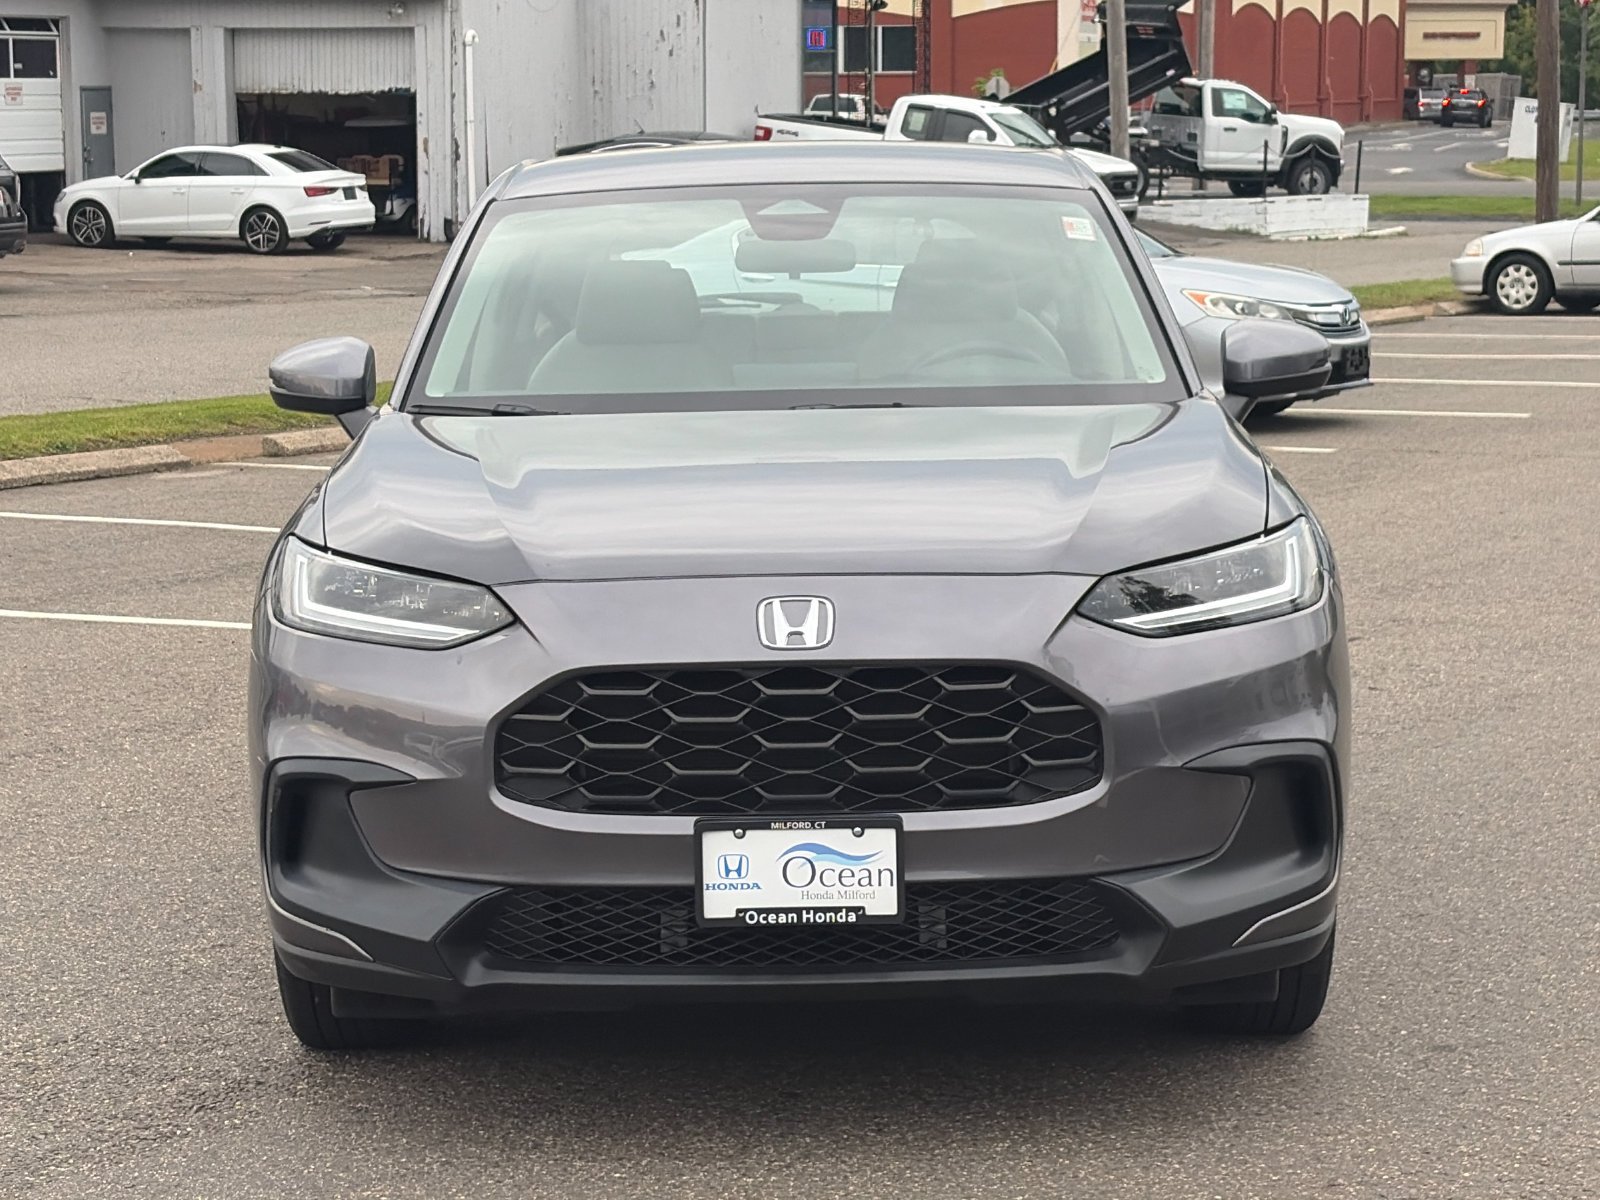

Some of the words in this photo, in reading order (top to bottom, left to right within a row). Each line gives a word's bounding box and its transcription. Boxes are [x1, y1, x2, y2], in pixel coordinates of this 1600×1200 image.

[815, 821, 827, 829] CT
[782, 855, 894, 888] Ocean
[704, 882, 762, 891] HONDA
[801, 890, 834, 900] Honda
[837, 890, 876, 900] Milford
[745, 910, 798, 924] Ocean
[802, 909, 857, 923] Honda
